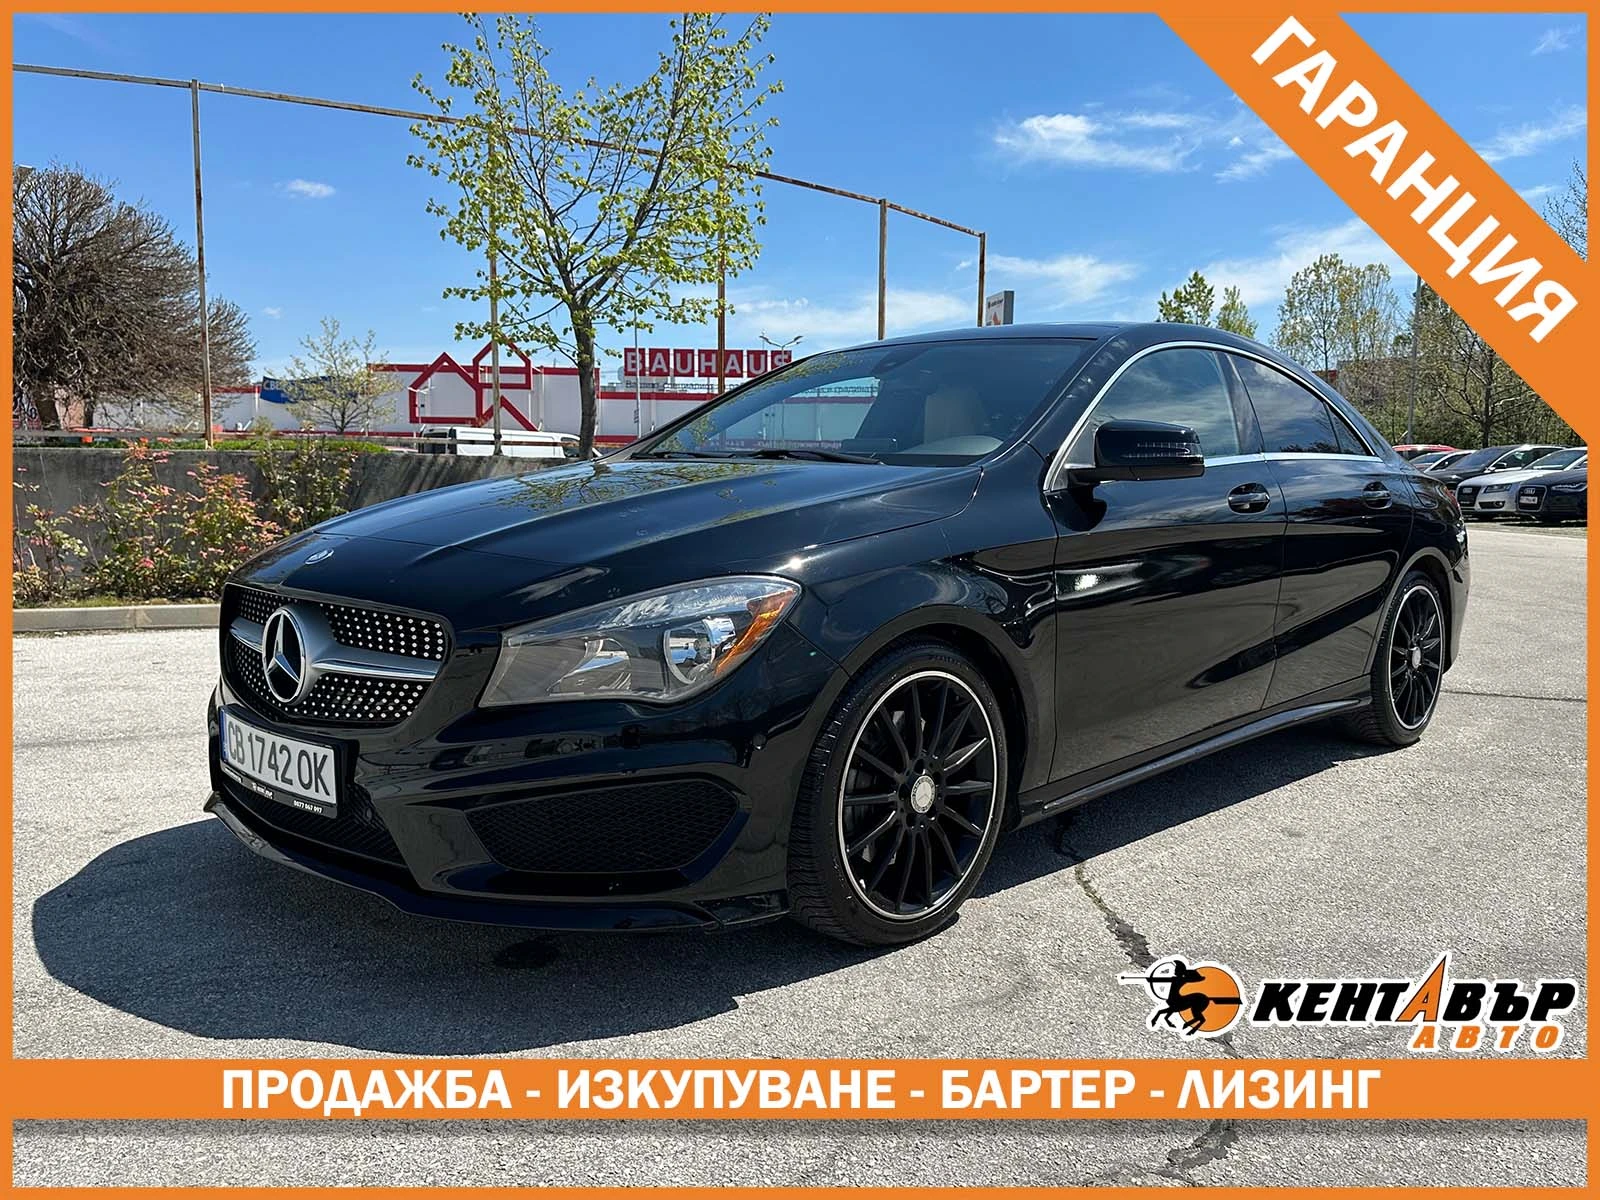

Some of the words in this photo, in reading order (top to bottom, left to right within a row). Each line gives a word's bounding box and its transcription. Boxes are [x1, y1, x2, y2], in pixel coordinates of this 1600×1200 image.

[626, 351, 791, 376] BAUHAUS
[247, 731, 294, 786] 1742
[297, 749, 331, 797] OK
